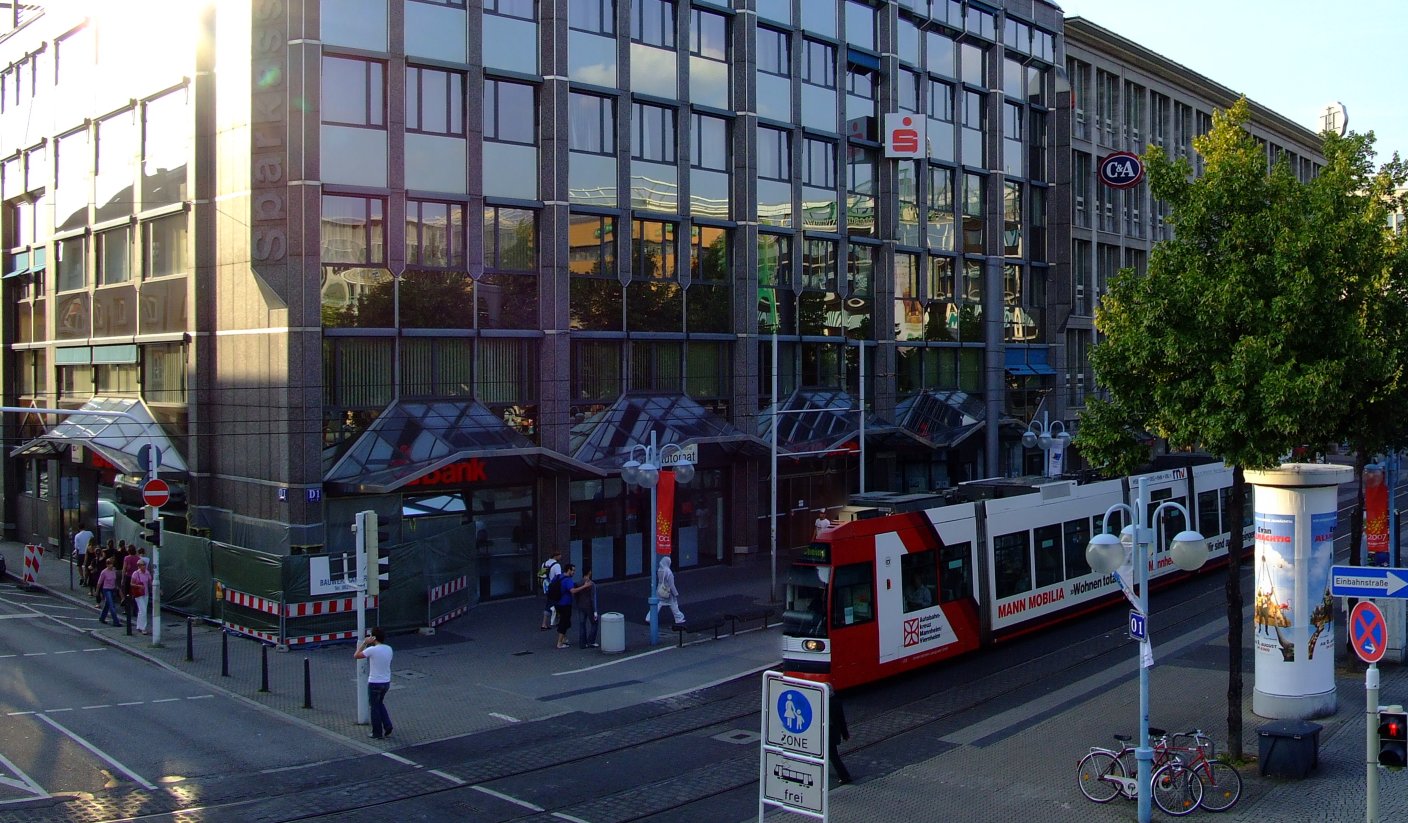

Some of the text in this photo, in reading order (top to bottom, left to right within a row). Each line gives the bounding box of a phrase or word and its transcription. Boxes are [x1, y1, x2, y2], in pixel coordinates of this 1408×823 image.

[1106, 162, 1135, 178] C&A
[1367, 533, 1387, 541] 2007
[1336, 577, 1389, 587] Einbahnstraße
[998, 601, 1026, 619] MANN
[1028, 587, 1065, 611] MOBILIA
[781, 731, 808, 749] ZONE
[784, 789, 804, 804] frei
